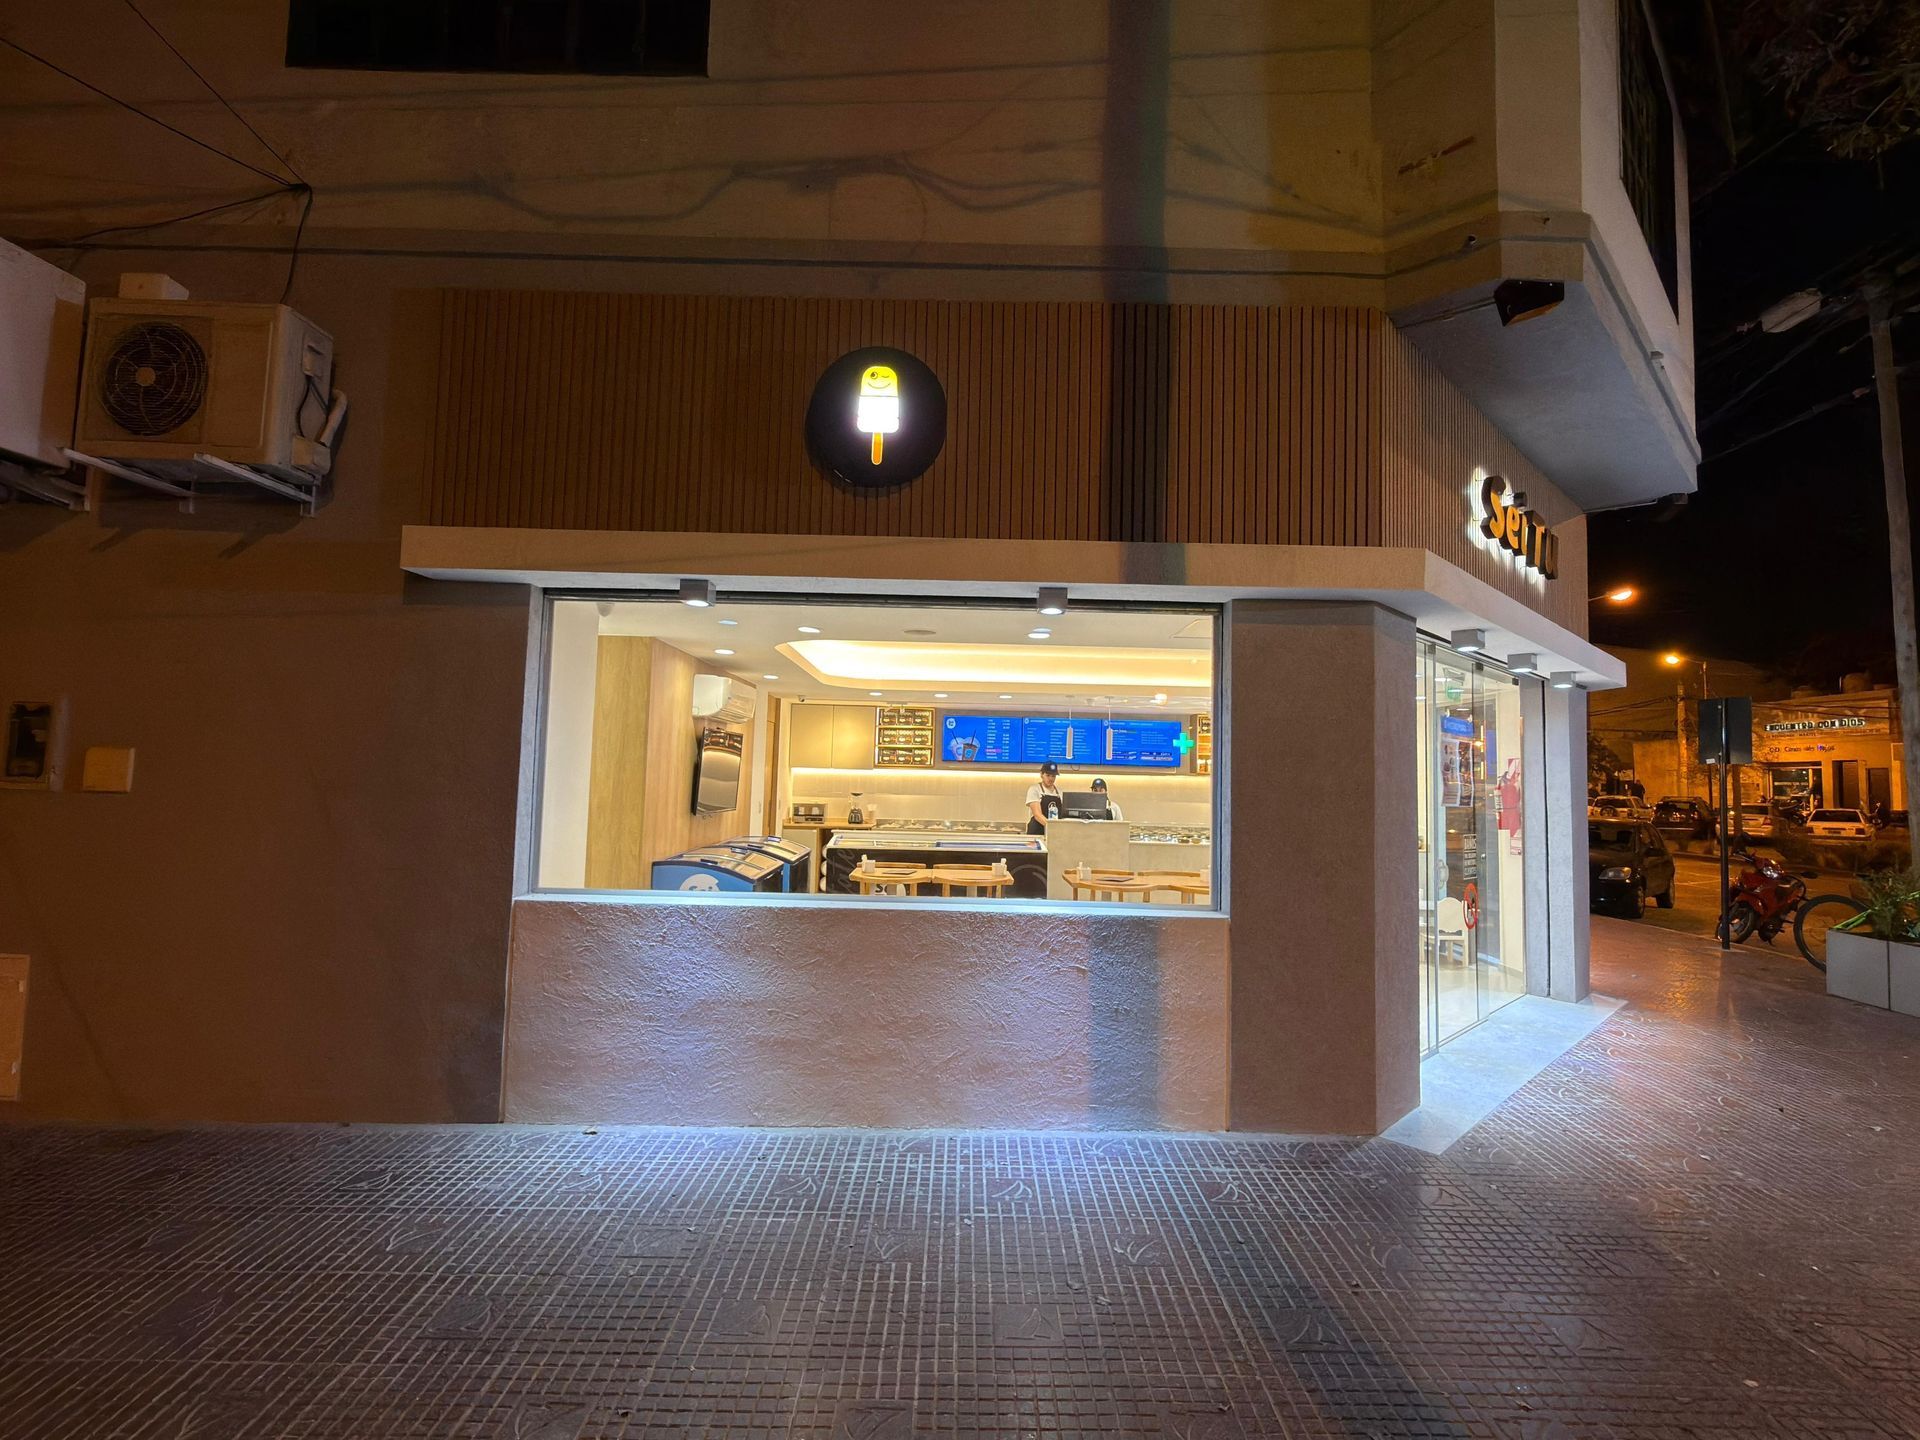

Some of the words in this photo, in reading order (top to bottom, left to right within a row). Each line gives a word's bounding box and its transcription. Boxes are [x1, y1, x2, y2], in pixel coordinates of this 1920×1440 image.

[1481, 476, 1527, 556] Sei
[1764, 721, 1814, 732] ENCUENTRO
[1817, 720, 1837, 729] CON
[1840, 718, 1865, 727] DIOS
